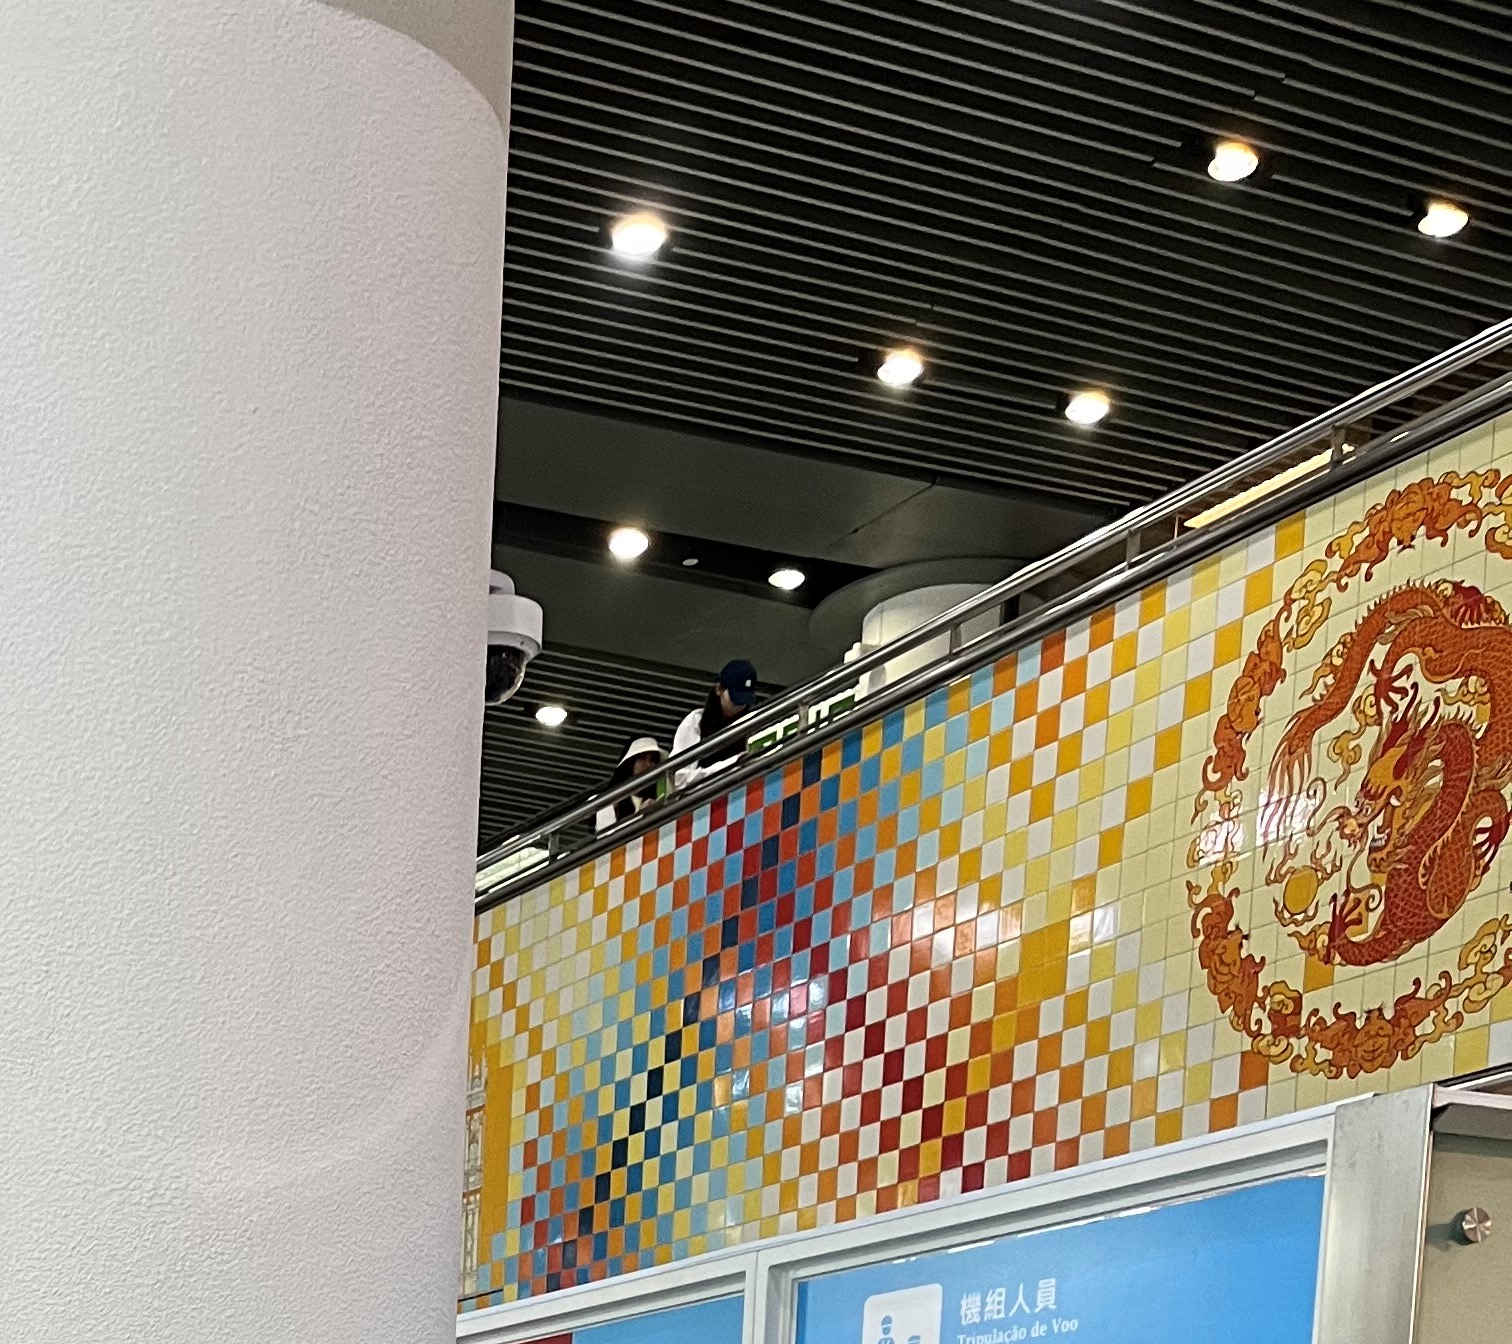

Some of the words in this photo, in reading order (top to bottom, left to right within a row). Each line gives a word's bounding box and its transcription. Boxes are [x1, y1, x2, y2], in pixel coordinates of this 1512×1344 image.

[961, 1279, 1057, 1325] 機組人員
[1030, 1320, 1048, 1338] de
[1051, 1317, 1079, 1334] Voo
